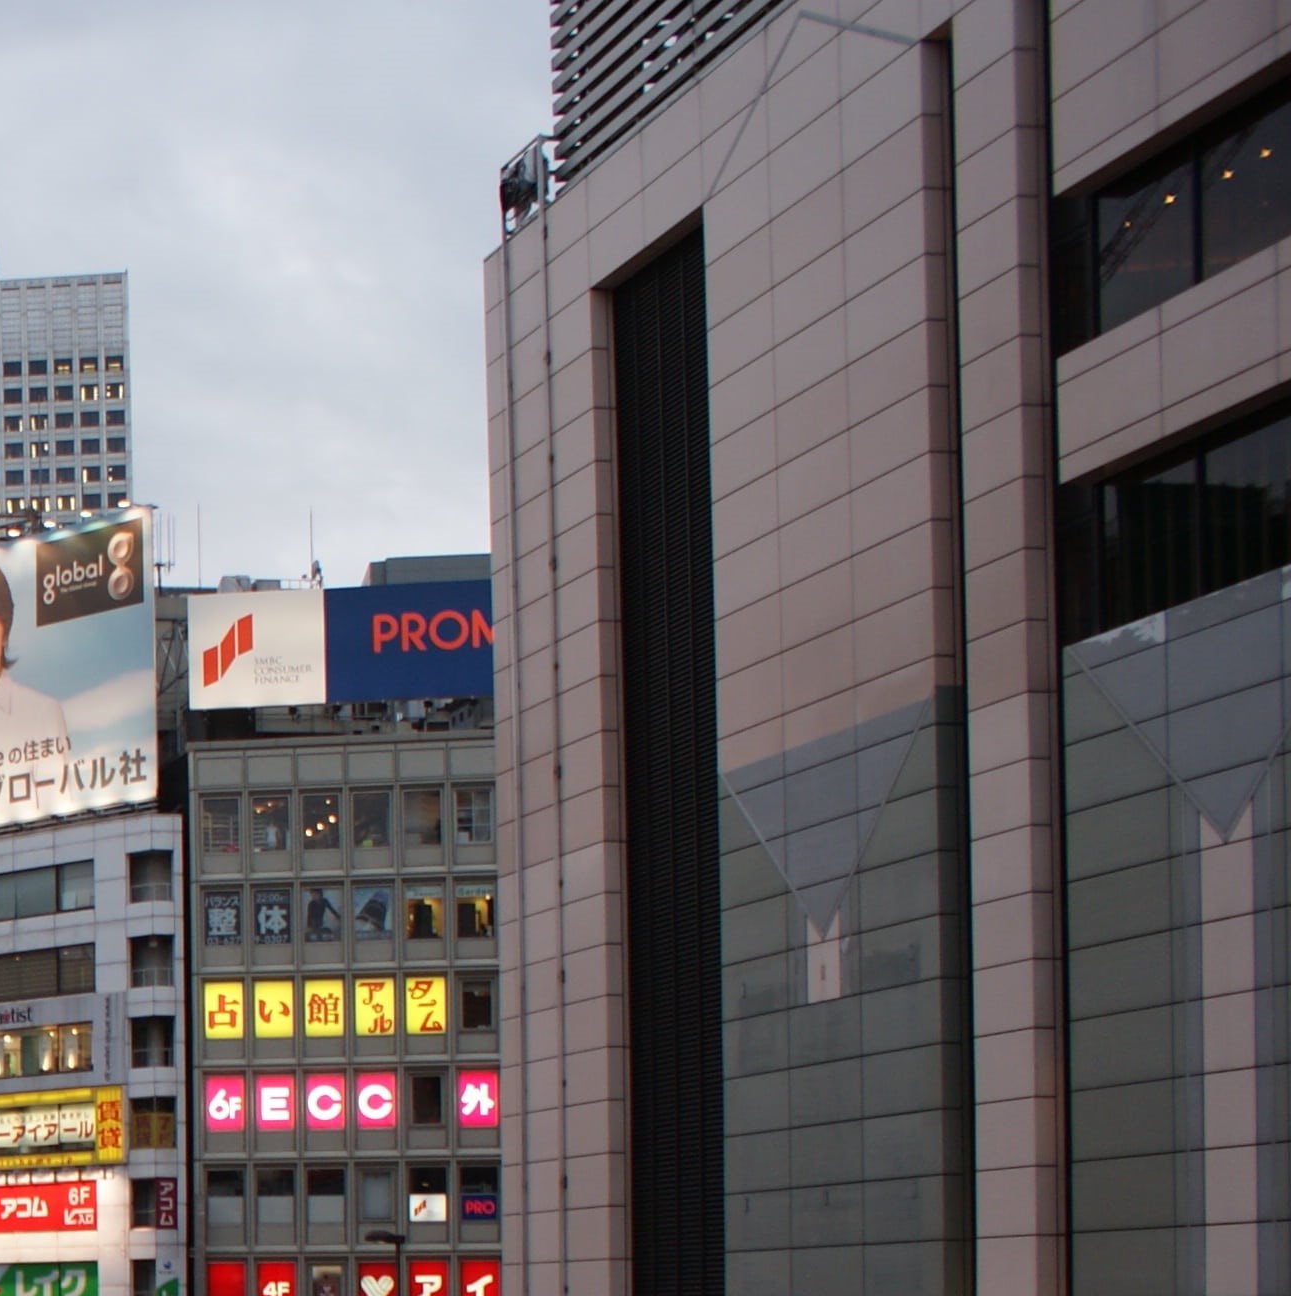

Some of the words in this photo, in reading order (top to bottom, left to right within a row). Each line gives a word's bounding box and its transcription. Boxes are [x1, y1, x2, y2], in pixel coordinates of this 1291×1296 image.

[43, 554, 103, 605] global
[253, 655, 282, 666] SMBC
[253, 664, 312, 677] CONSUMER
[254, 675, 300, 686] FINANCE
[8, 735, 72, 763] の住まい
[207, 992, 341, 1030] 占い館
[208, 1088, 242, 1121] 6F
[260, 1083, 394, 1122] ECC
[461, 1082, 495, 1117] 外
[0, 1195, 49, 1221] アコム
[69, 1186, 91, 1205] 6F
[159, 1181, 174, 1227] アコム
